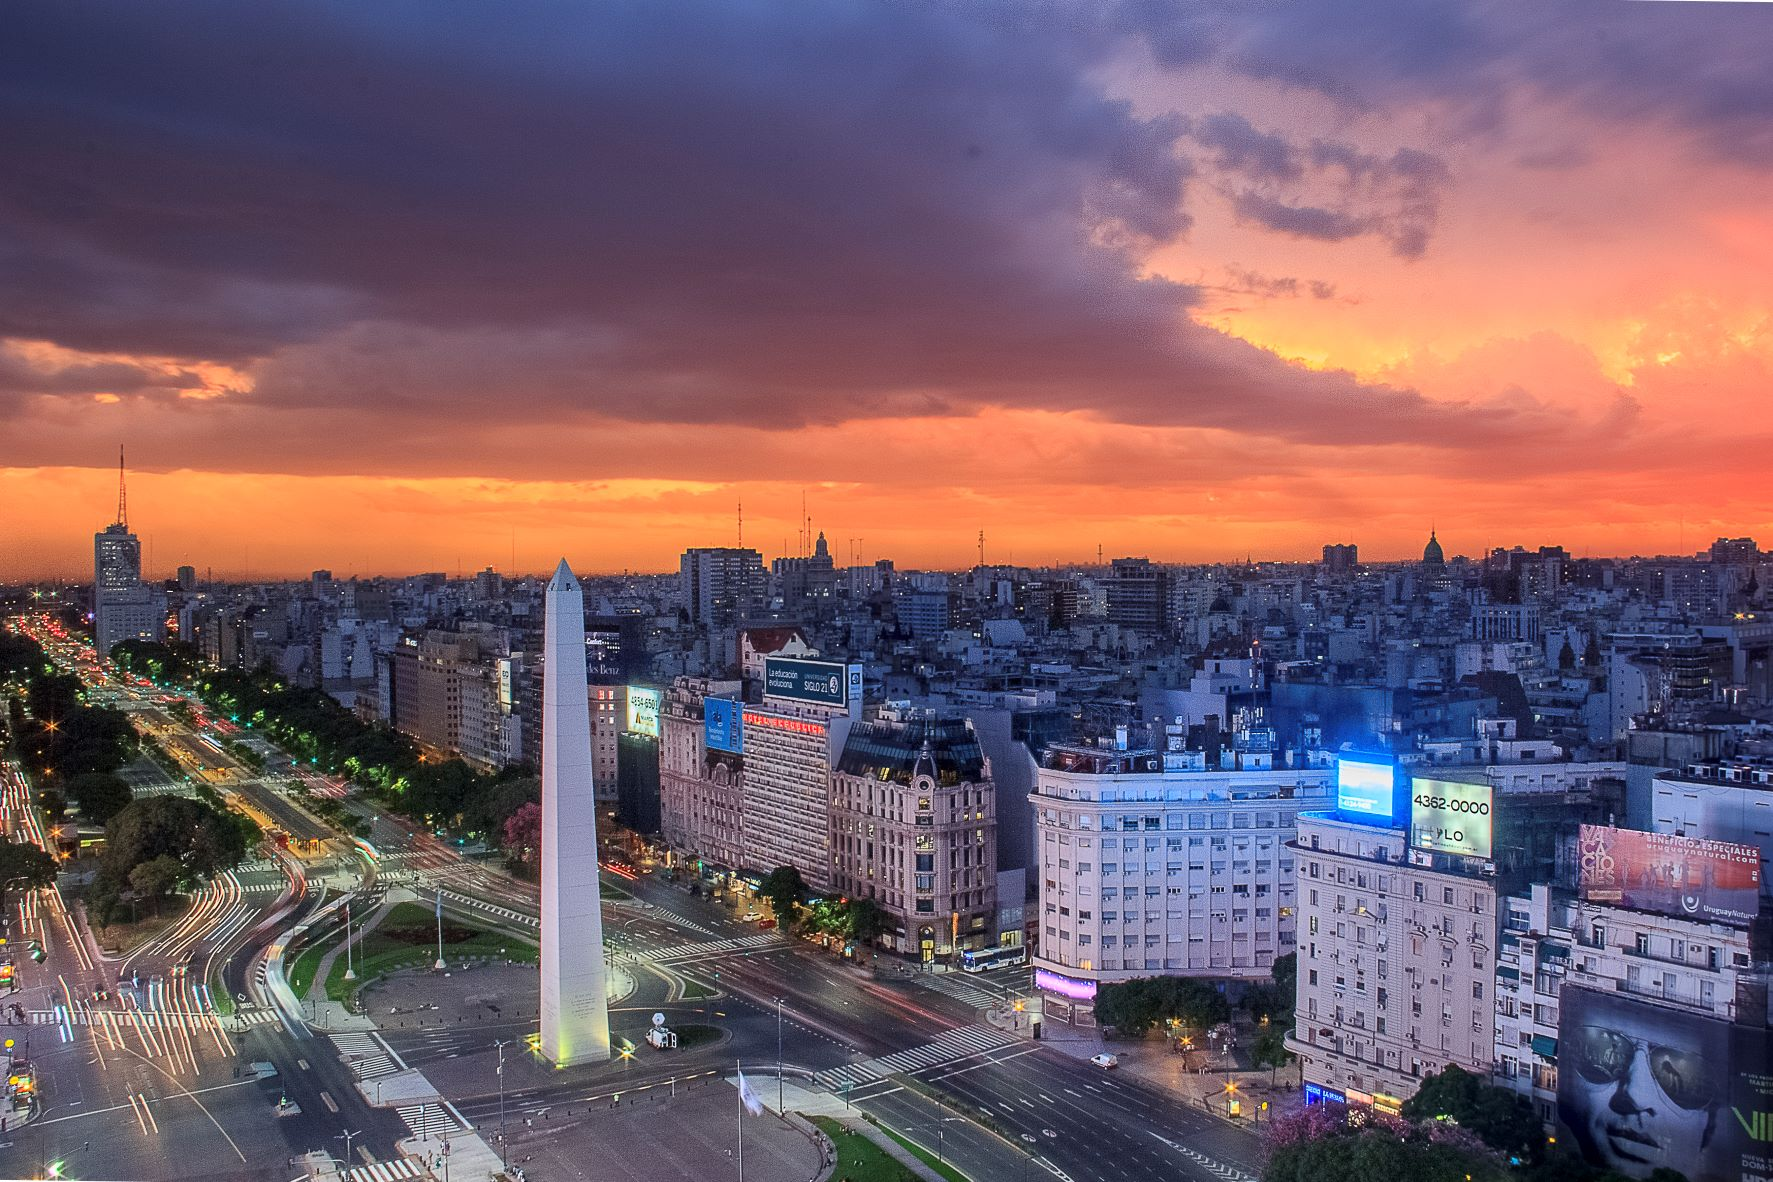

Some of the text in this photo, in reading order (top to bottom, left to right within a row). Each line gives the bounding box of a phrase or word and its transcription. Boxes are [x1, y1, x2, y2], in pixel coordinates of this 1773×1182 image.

[600, 664, 619, 674] Benz
[768, 669, 798, 679] La educación
[804, 680, 828, 693] SIGLO 21
[1414, 795, 1489, 815] 4362-0000
[1646, 843, 1758, 865] uruguaynatural.com
[1702, 842, 1758, 857] ESPECIALES
[1741, 1153, 1764, 1163] NUEVA
